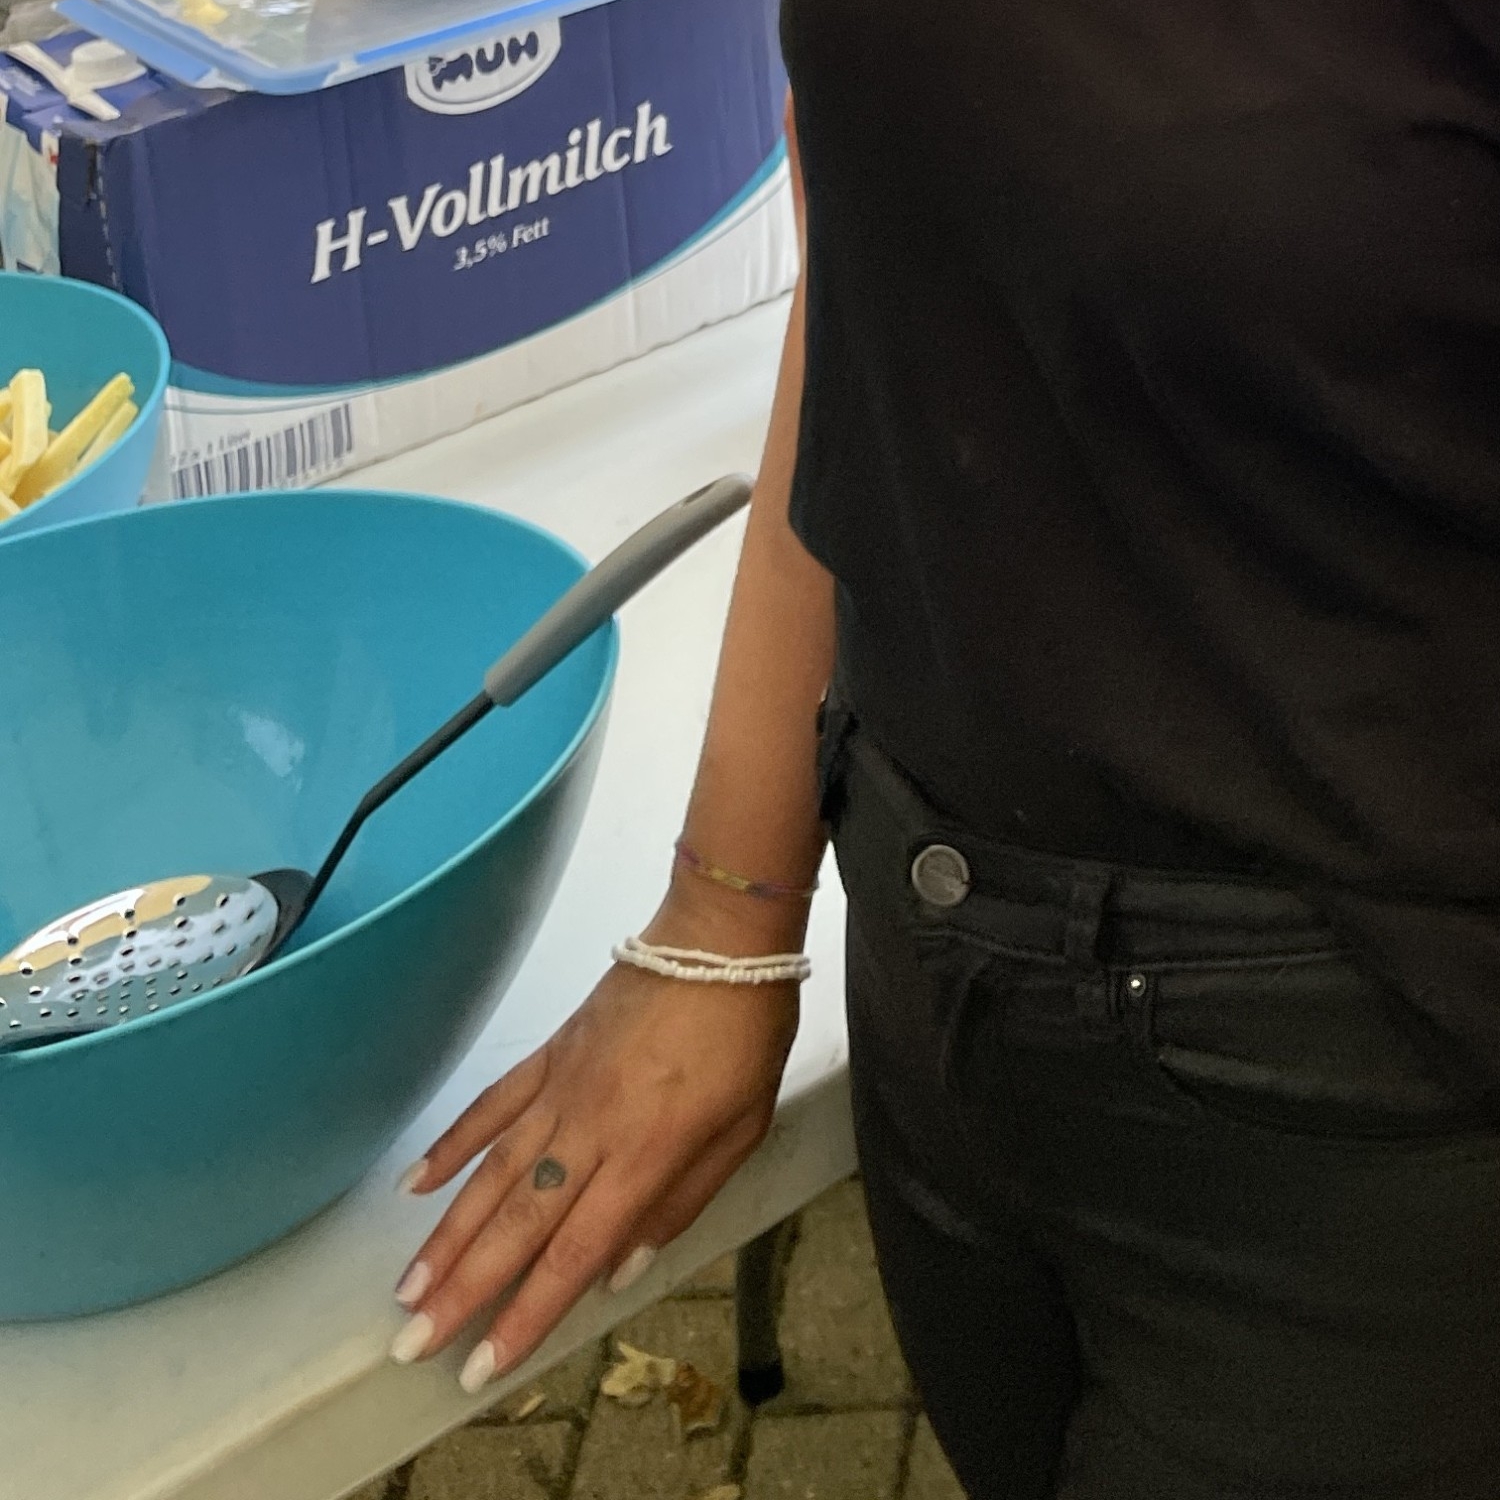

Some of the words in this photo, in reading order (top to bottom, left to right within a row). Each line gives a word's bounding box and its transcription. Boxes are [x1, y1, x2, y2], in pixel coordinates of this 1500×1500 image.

[310, 100, 673, 284] H-Vollmilch
[453, 233, 508, 271] 3,5%
[511, 217, 549, 249] Fett
